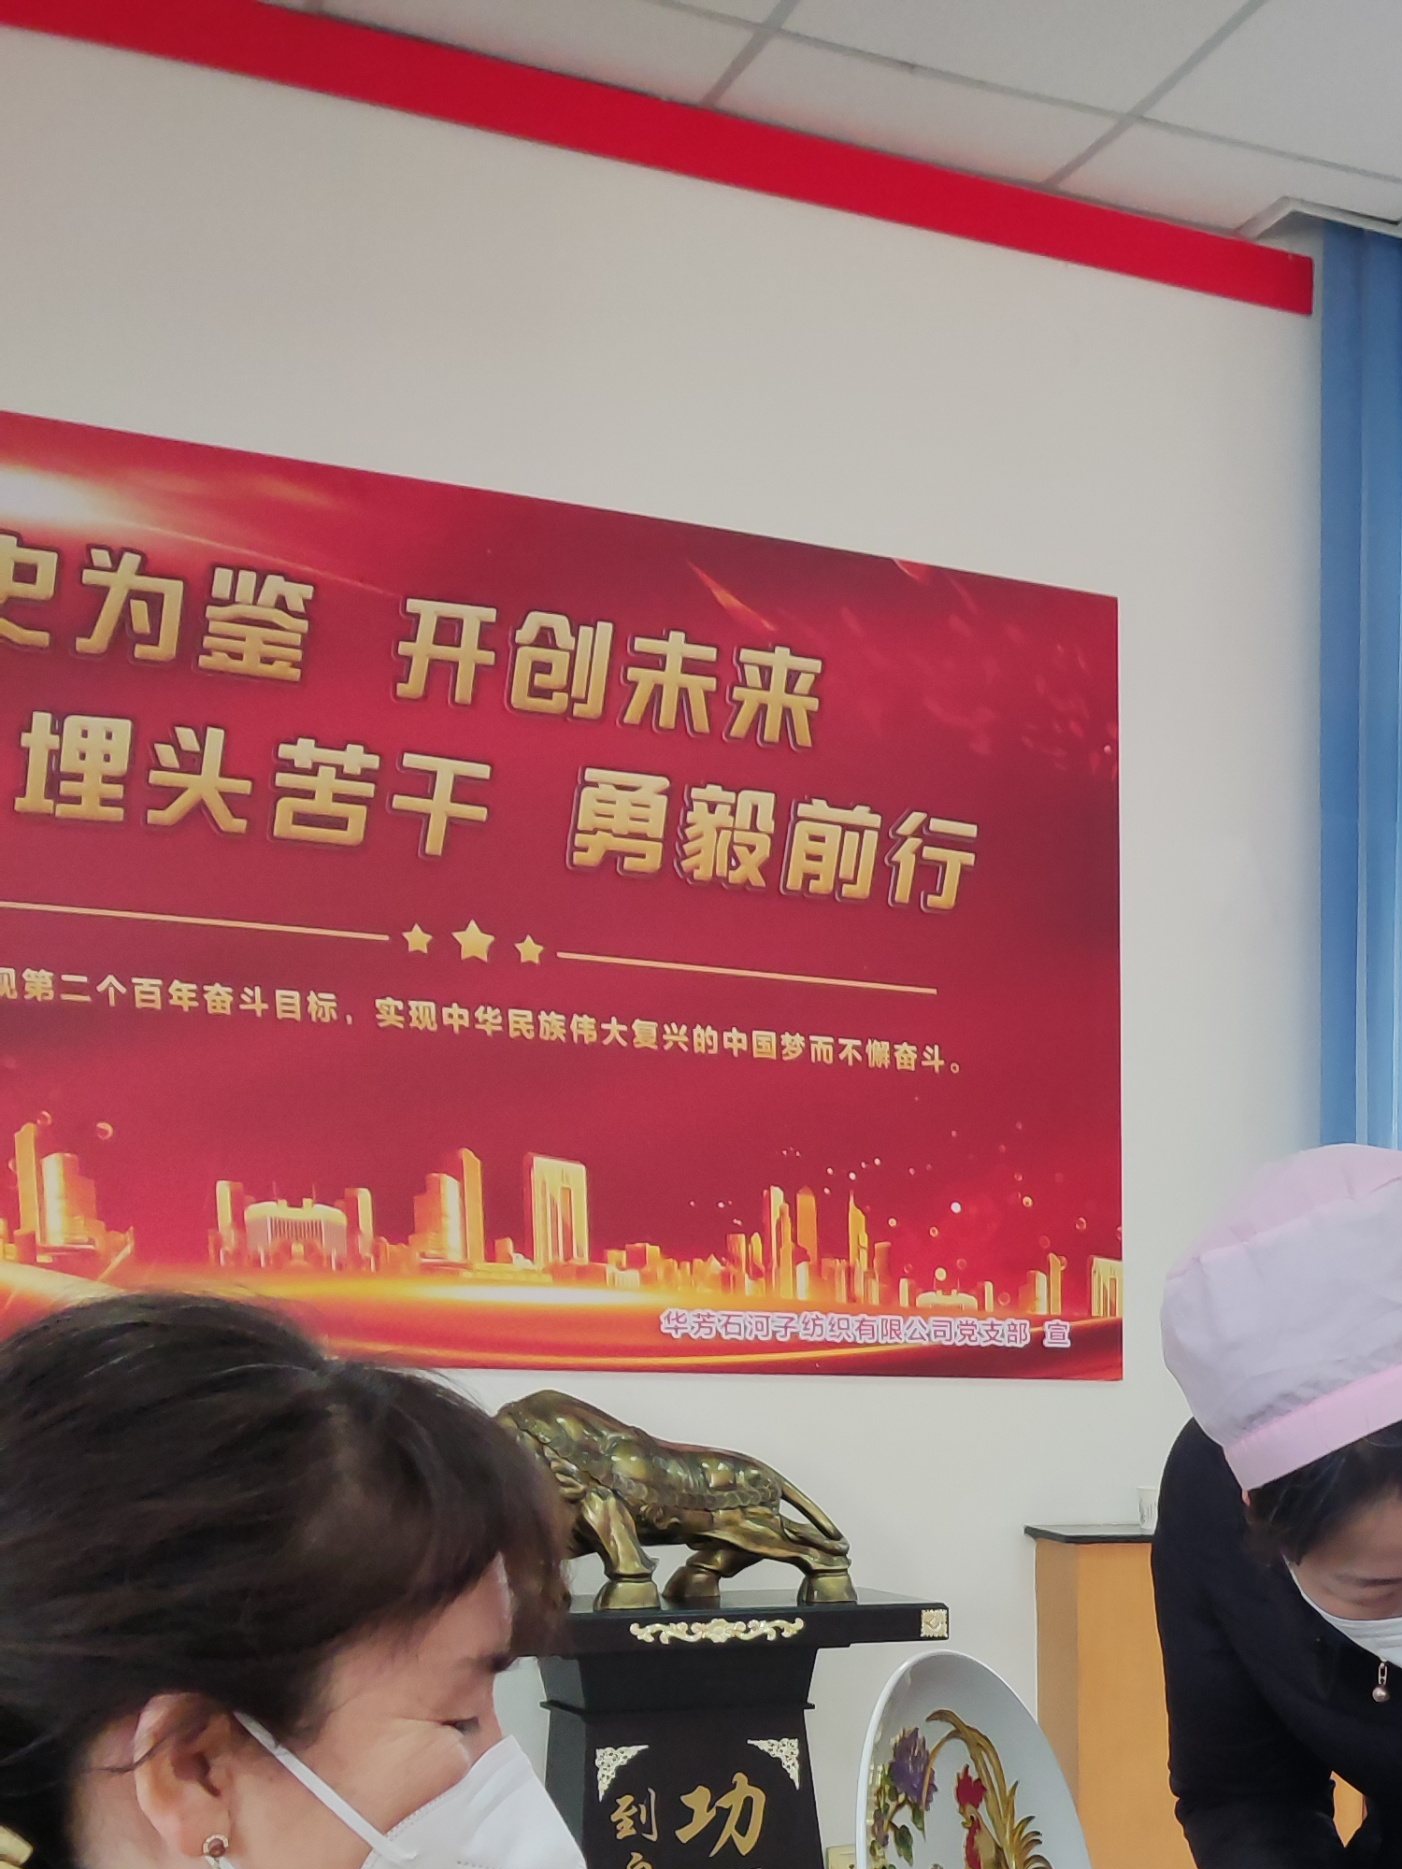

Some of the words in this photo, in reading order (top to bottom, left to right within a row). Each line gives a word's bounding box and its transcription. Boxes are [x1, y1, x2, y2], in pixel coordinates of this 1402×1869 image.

[396, 598, 824, 750] 开创未来
[16, 711, 493, 858] 埋头苦干
[571, 767, 979, 911] 勇毅前行
[662, 1308, 1031, 1348] 华芳石河子纺织有限公司党支部
[1043, 1318, 1071, 1349] 宣
[674, 1771, 767, 1858] 功
